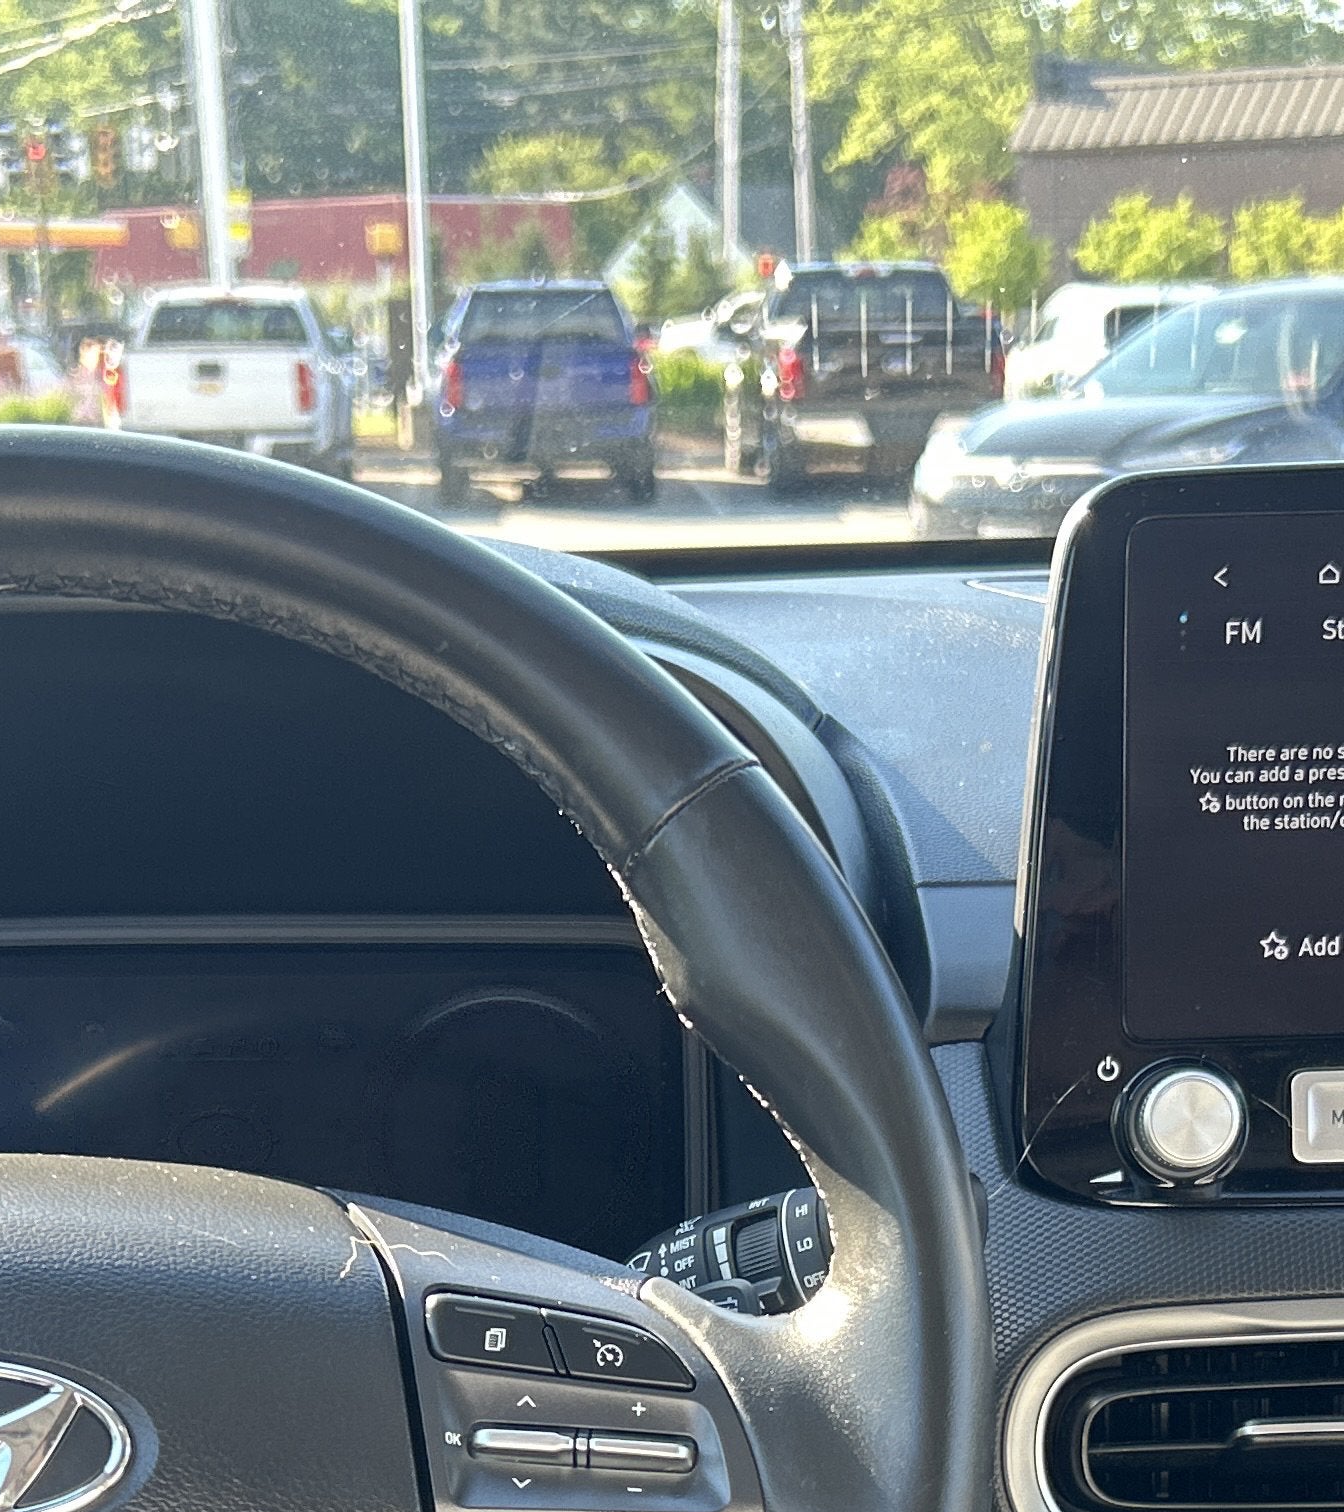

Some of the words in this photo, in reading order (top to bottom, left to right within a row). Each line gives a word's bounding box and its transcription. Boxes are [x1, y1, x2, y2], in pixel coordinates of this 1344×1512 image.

[1225, 621, 1262, 644] FM
[1226, 745, 1274, 763] There
[1280, 748, 1309, 762] are
[1313, 745, 1333, 760] no
[1189, 767, 1221, 785] You
[1225, 768, 1254, 783] can
[1259, 765, 1290, 782] add
[1295, 768, 1304, 781] a
[1225, 793, 1277, 810] button
[1283, 794, 1303, 808] on
[1307, 791, 1335, 808] the
[1243, 814, 1270, 831] the
[1299, 937, 1340, 957] Add
[795, 1204, 808, 1218] HI
[670, 1235, 697, 1254] MIST
[796, 1237, 813, 1252] LO
[674, 1255, 694, 1272] OFF
[804, 1271, 825, 1288] OFF
[444, 1431, 462, 1446] OK
